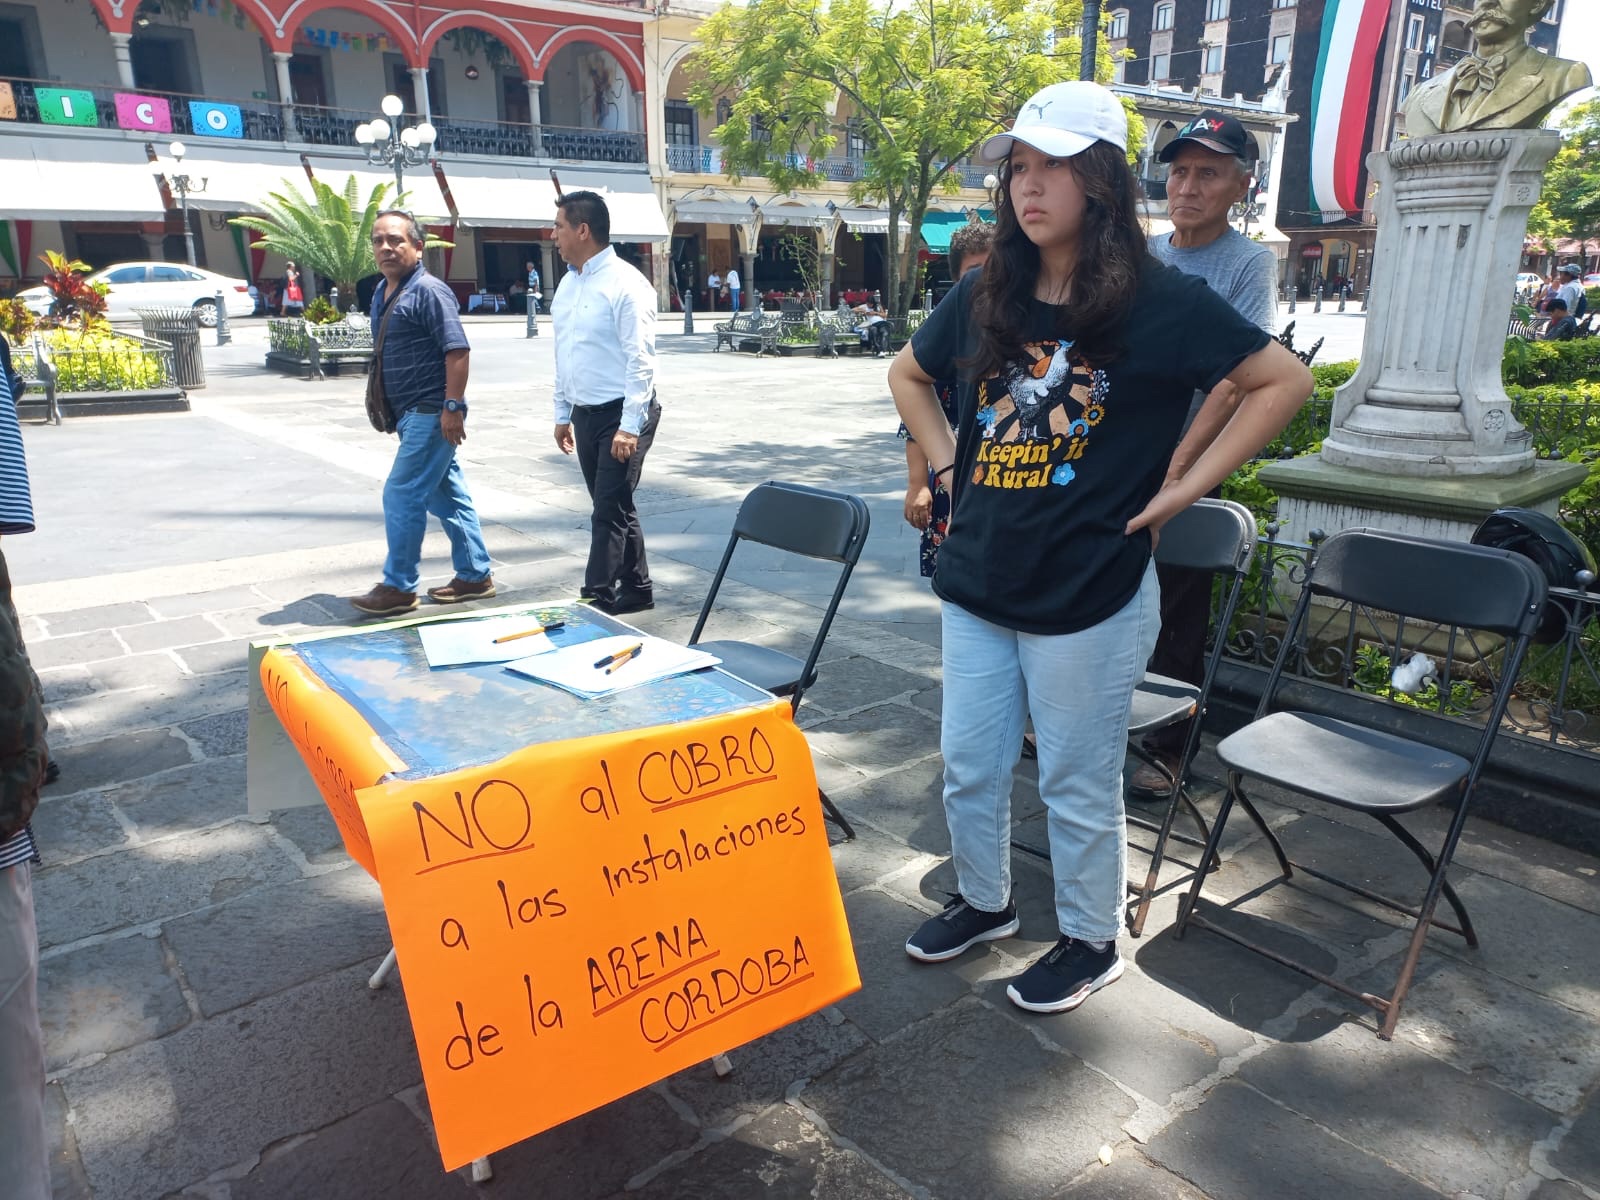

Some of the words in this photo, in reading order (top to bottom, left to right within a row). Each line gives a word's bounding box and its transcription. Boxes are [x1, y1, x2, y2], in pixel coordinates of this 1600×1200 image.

[1411, 0, 1443, 11] TEL
[976, 437, 1062, 468] Keepin'
[1063, 437, 1089, 461] it
[984, 463, 1053, 489] Rural
[413, 779, 531, 862] NO
[580, 759, 619, 820] al
[638, 727, 775, 805] COBRO
[440, 917, 470, 950] a
[497, 879, 568, 930] las
[602, 806, 807, 897] Instalaciones
[444, 1001, 504, 1071] de
[523, 974, 564, 1036] la
[587, 918, 709, 1009] ARENA
[639, 936, 810, 1045] CORDOBA
